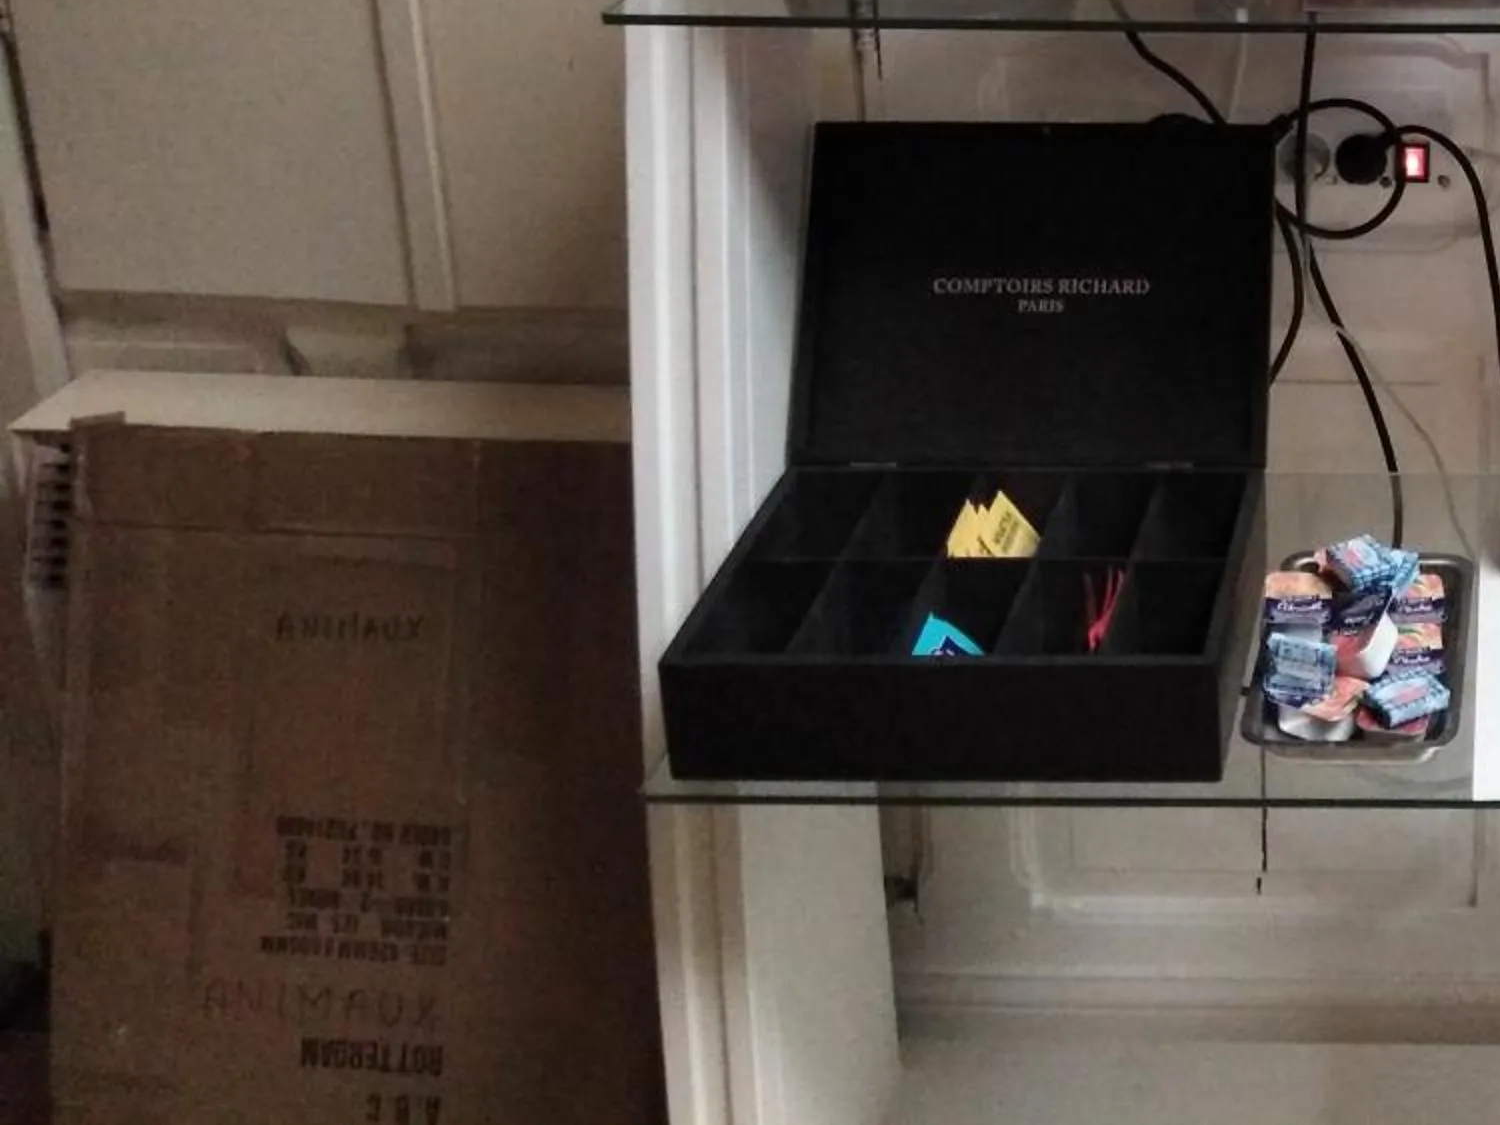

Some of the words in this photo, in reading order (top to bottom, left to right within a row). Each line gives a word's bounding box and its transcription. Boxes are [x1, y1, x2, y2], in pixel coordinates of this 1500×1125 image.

[932, 277, 1052, 294] COMPTOIRS
[1058, 277, 1151, 294] RICHARD
[1017, 298, 1065, 313] PARIS
